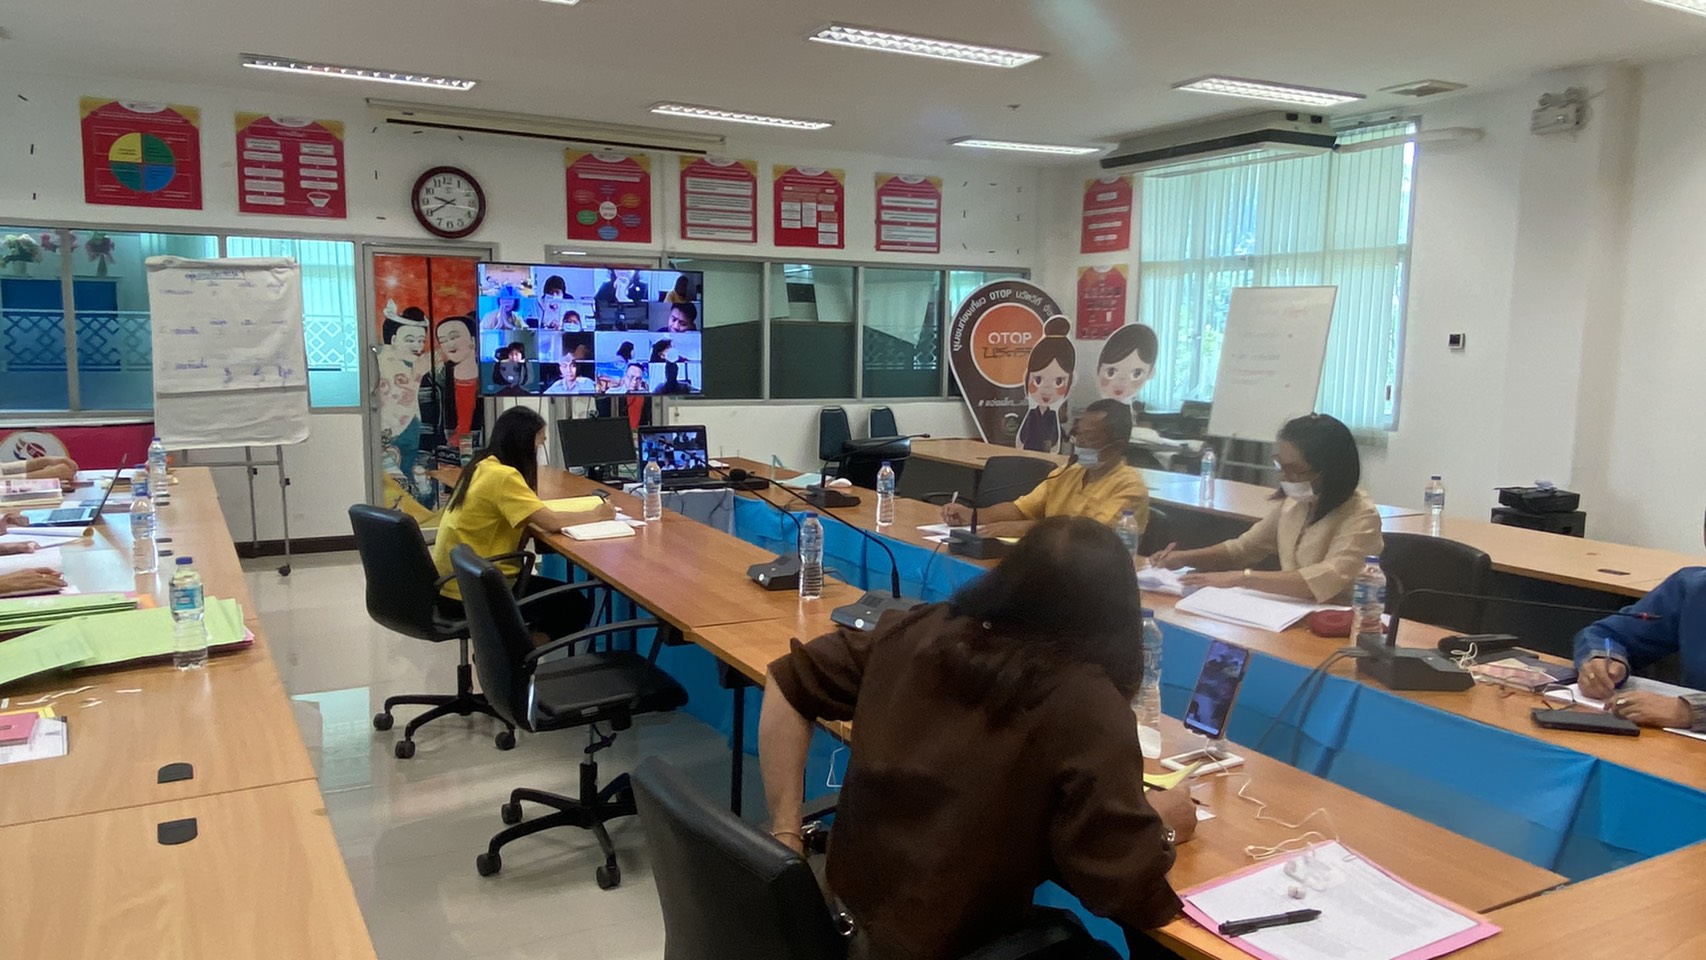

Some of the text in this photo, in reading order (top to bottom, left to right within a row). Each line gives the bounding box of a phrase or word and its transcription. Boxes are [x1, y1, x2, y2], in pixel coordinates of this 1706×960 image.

[443, 177, 452, 185] 12
[989, 289, 1013, 301] OTOP
[988, 332, 1032, 344] OTOP
